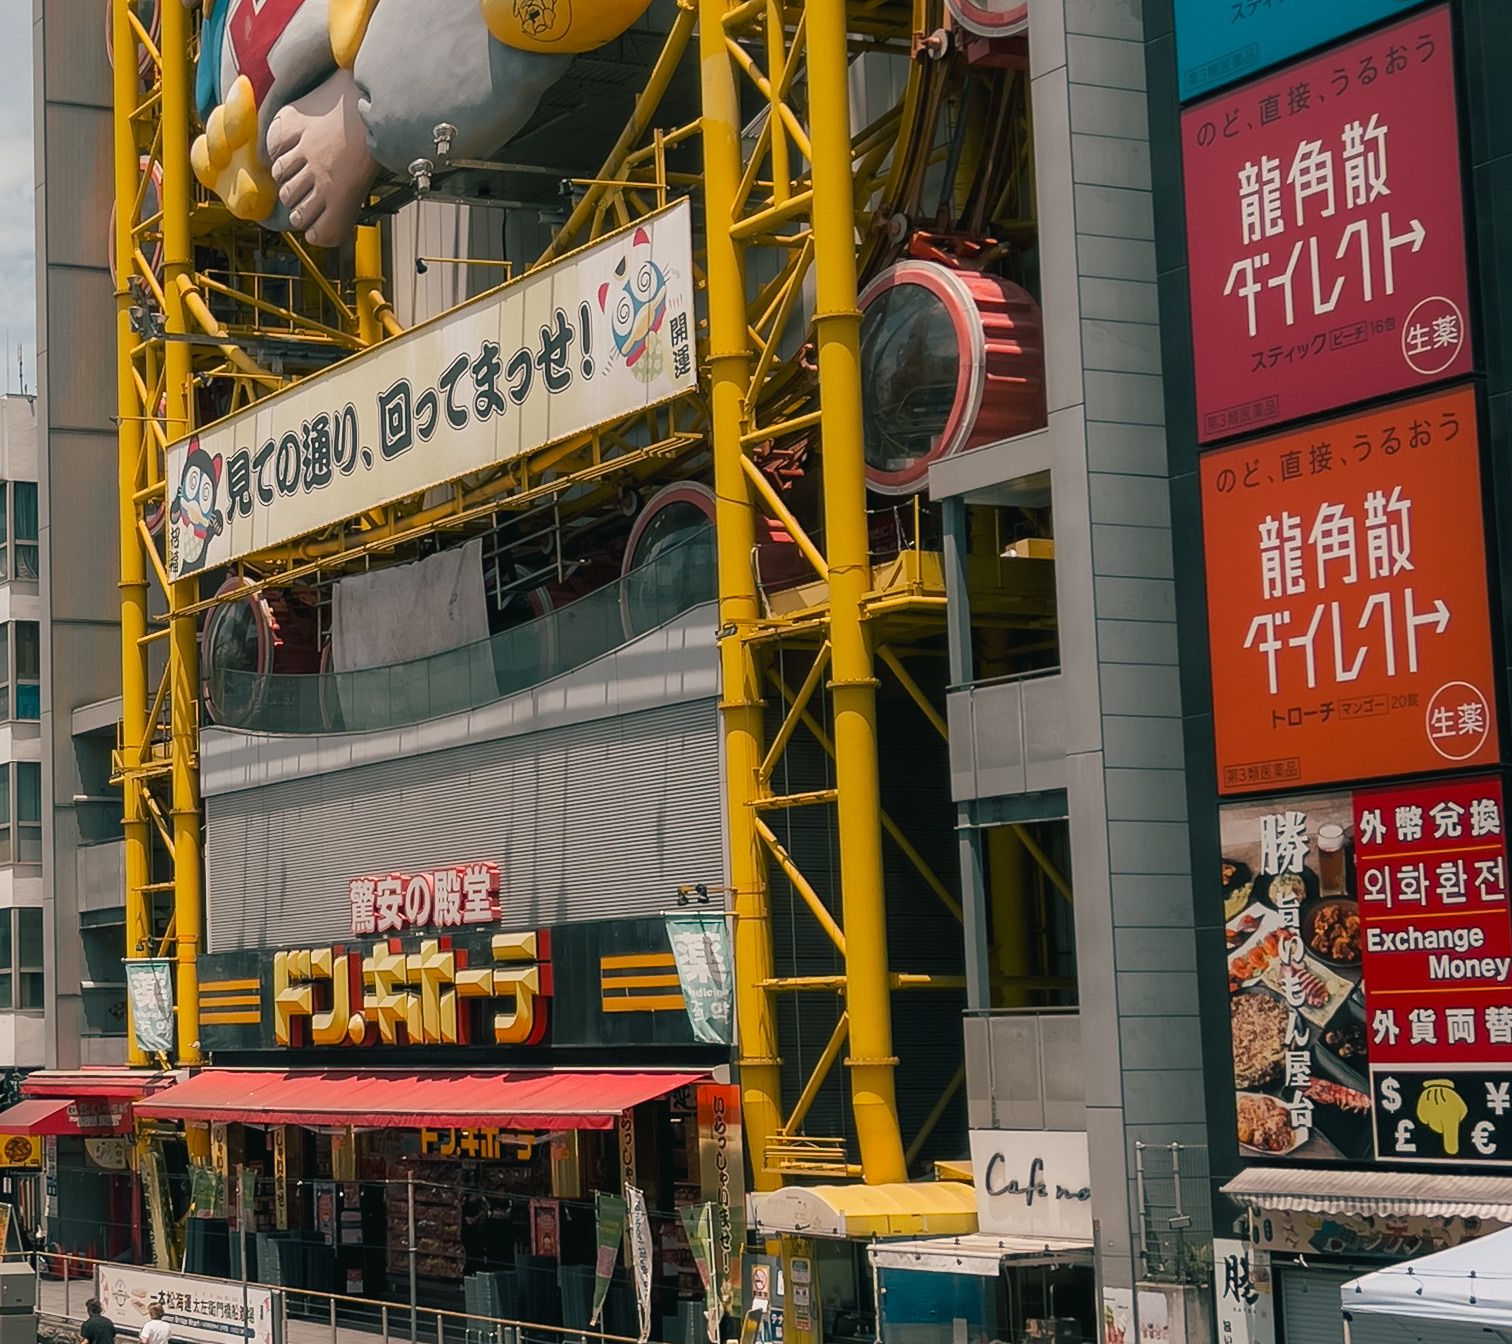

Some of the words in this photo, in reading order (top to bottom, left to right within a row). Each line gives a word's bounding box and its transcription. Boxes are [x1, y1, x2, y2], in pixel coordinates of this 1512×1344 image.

[1237, 113, 1391, 246] 龍角散
[1222, 209, 1427, 338] ダイレクト
[1251, 333, 1328, 373] スティック
[1407, 314, 1459, 357] 生薬
[1258, 486, 1416, 602] 龍角散
[1243, 590, 1451, 696] ダイレクト
[1271, 701, 1336, 729] トローチ
[1431, 702, 1484, 739] 生薬
[1259, 811, 1310, 875] 勝
[1360, 798, 1502, 844] 外幣兌換
[349, 862, 498, 934] 驚安の殿堂
[1363, 856, 1506, 908] 외화환전
[1366, 926, 1485, 953] Exchange
[1428, 955, 1512, 983] Money
[1372, 1006, 1512, 1046] 外貨両替
[985, 1152, 1049, 1207] Cafe
